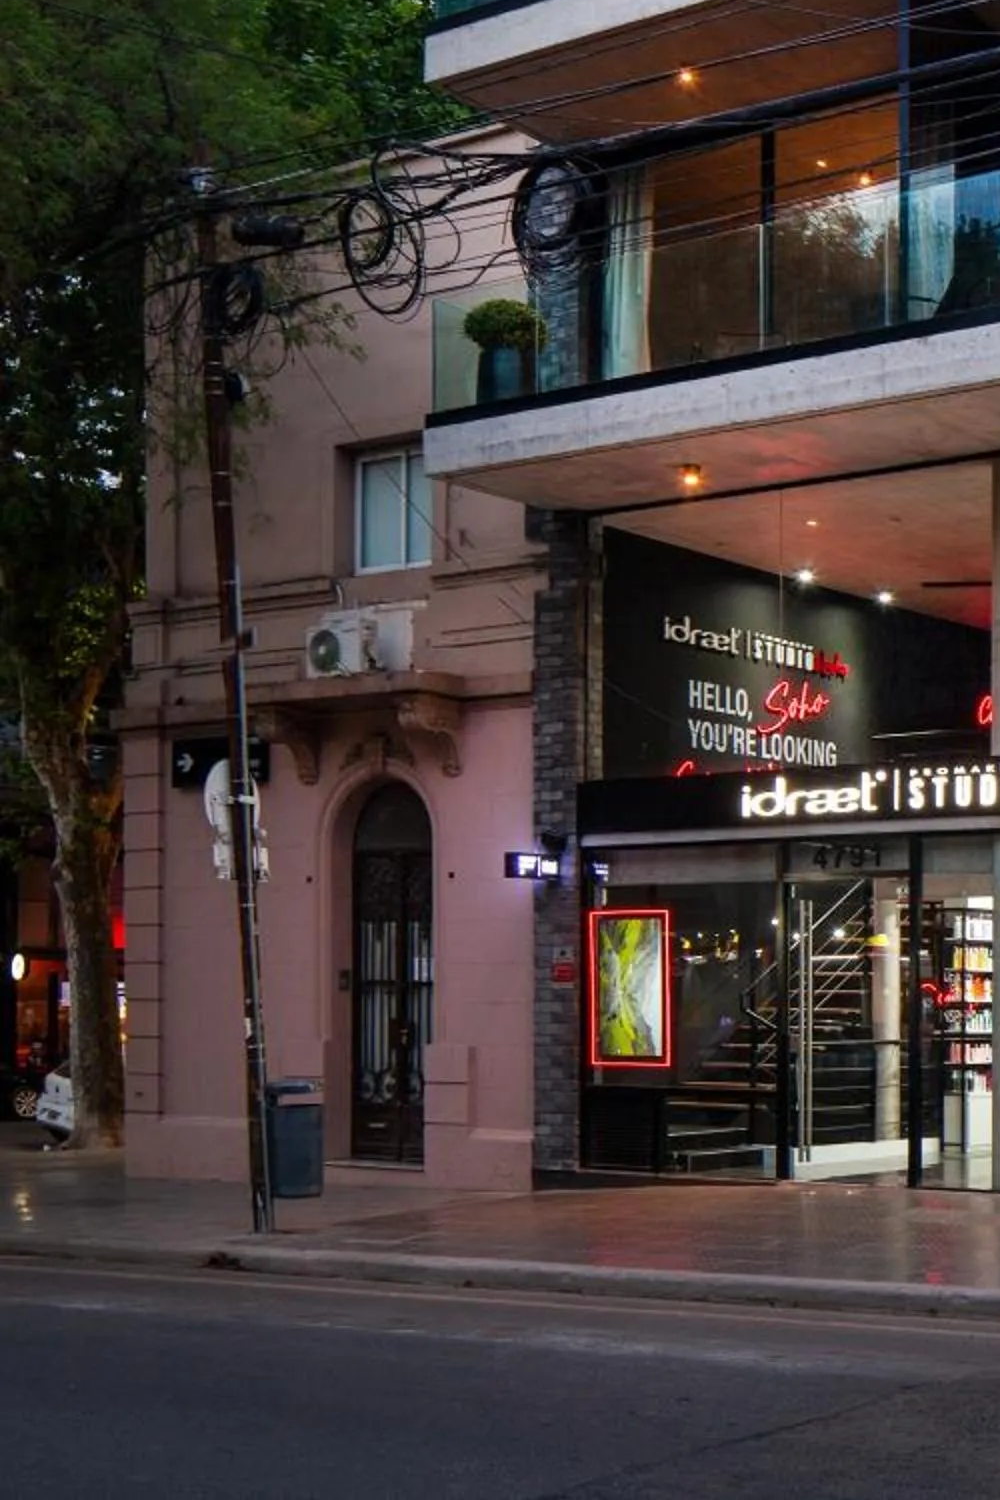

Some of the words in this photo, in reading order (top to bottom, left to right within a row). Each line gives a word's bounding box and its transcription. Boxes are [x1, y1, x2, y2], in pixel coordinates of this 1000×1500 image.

[688, 679, 753, 722] HELLO,
[757, 681, 829, 733] Soho
[688, 719, 757, 757] YOU'RE
[761, 733, 837, 767] LOOKING
[813, 844, 881, 869] 4791
